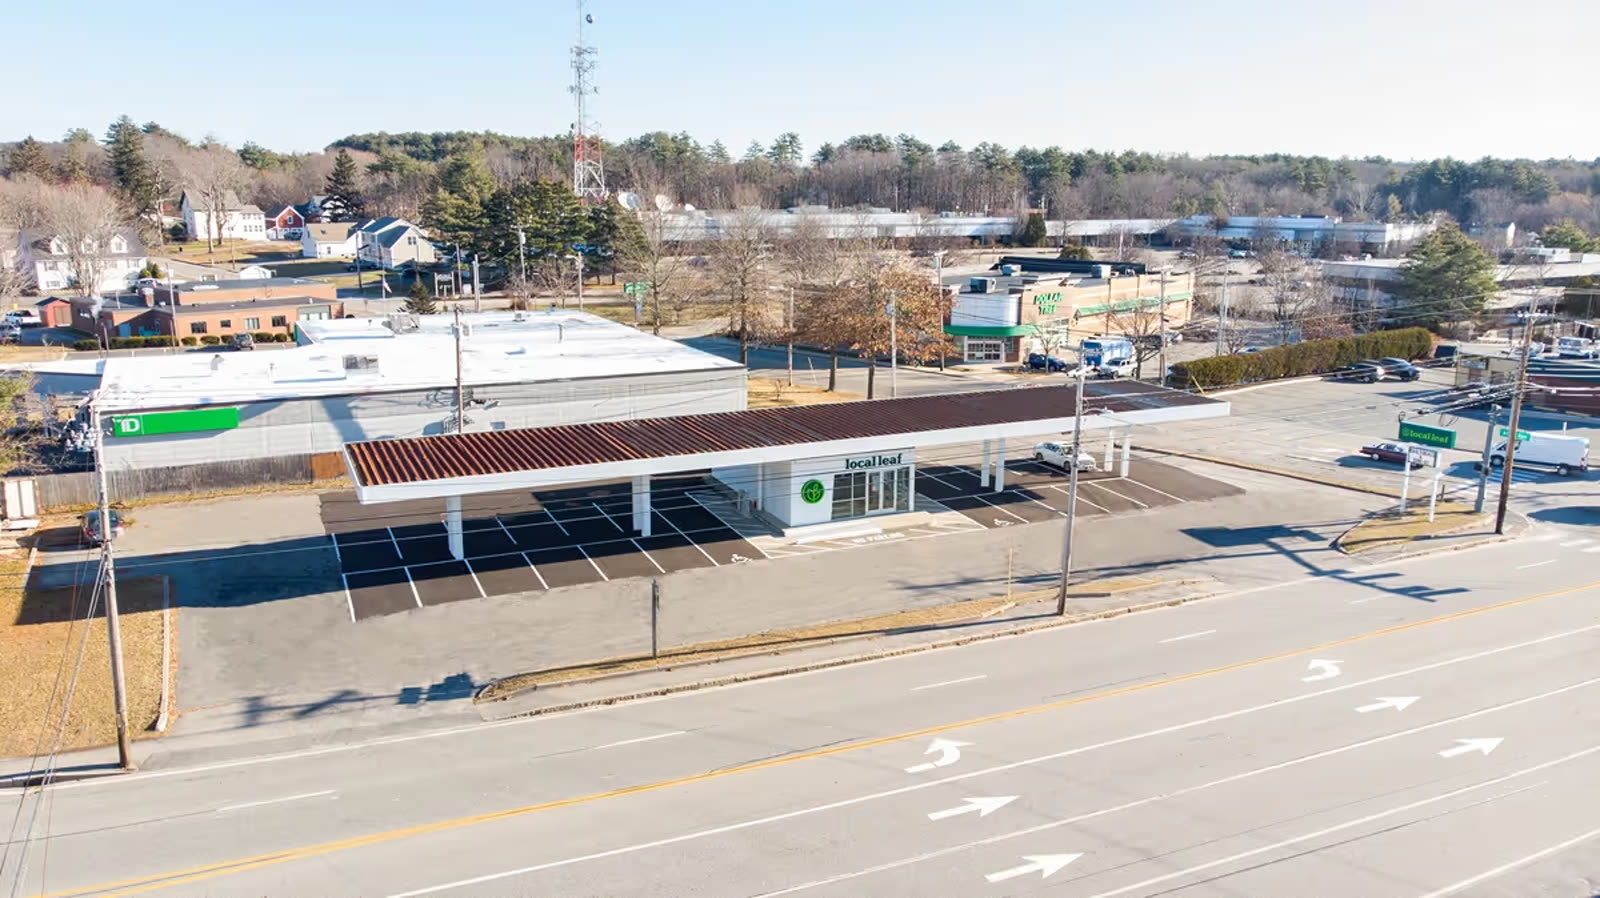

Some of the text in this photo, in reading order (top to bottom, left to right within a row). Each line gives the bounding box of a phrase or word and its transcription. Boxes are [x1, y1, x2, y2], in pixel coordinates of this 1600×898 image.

[1033, 292, 1063, 304] DOLLAR
[1410, 430, 1449, 444] local leaf
[845, 452, 903, 470] local leaf
